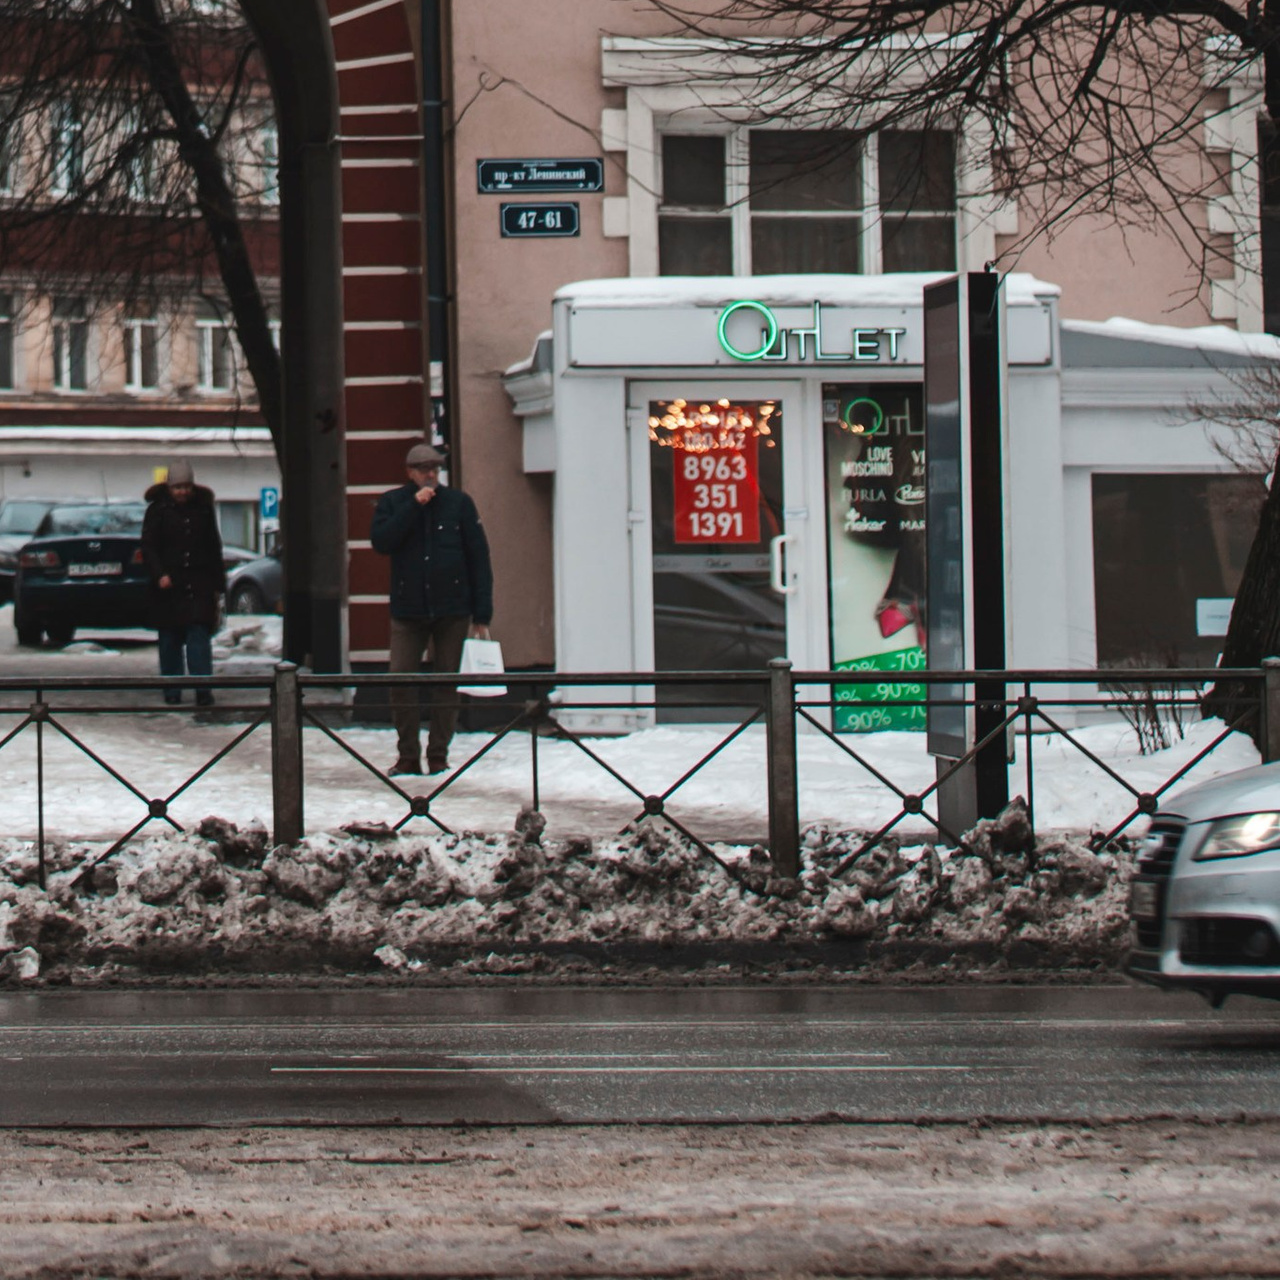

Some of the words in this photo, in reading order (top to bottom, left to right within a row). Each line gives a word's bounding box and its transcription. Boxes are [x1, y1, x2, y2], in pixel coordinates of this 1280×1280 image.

[528, 168, 586, 180] Ленинский
[518, 211, 562, 229] 47-61
[867, 446, 893, 461] LOVE
[684, 456, 747, 481] 8963
[841, 461, 894, 476] MOSCHINO
[264, 490, 277, 513] P
[694, 484, 738, 508] 351
[689, 512, 744, 537] 1391
